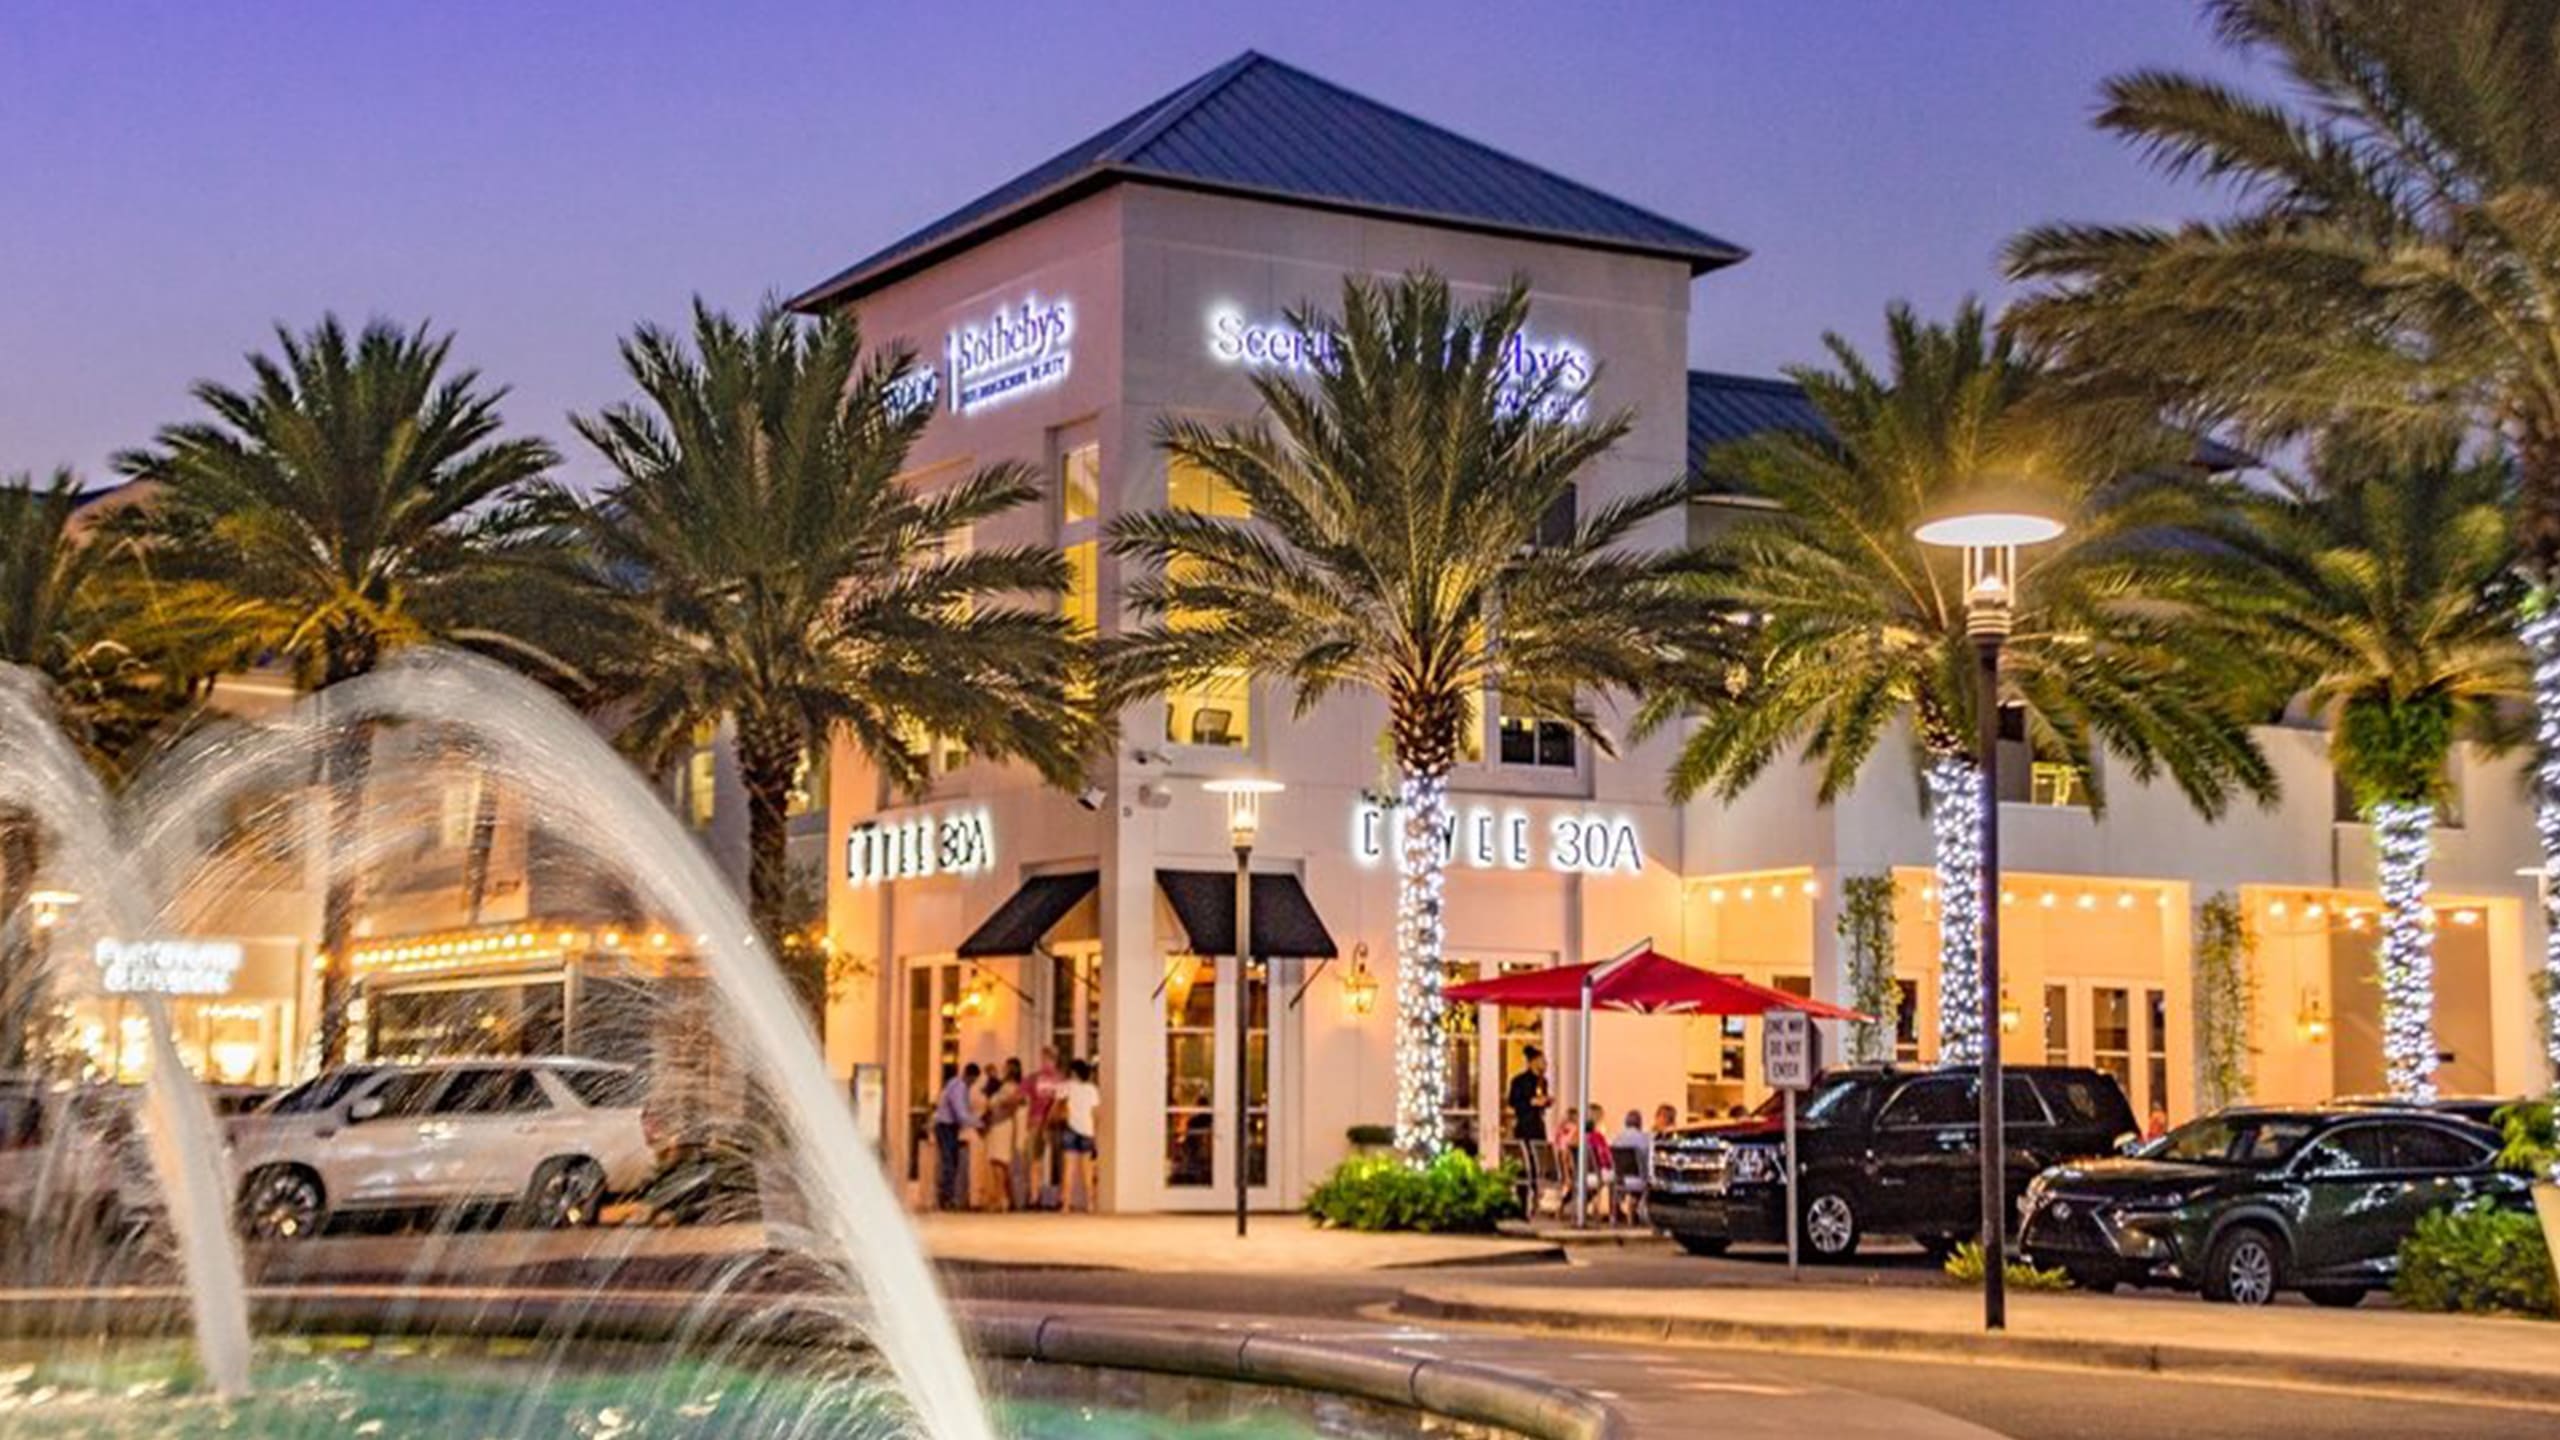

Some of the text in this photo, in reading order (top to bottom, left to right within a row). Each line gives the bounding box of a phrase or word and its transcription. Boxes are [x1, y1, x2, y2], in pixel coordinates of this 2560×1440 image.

[958, 302, 1065, 373] Sotheby's
[938, 818, 986, 868] 30A
[1364, 811, 1642, 870] CVEE 30A
[1769, 1040, 1801, 1056] DO NOT
